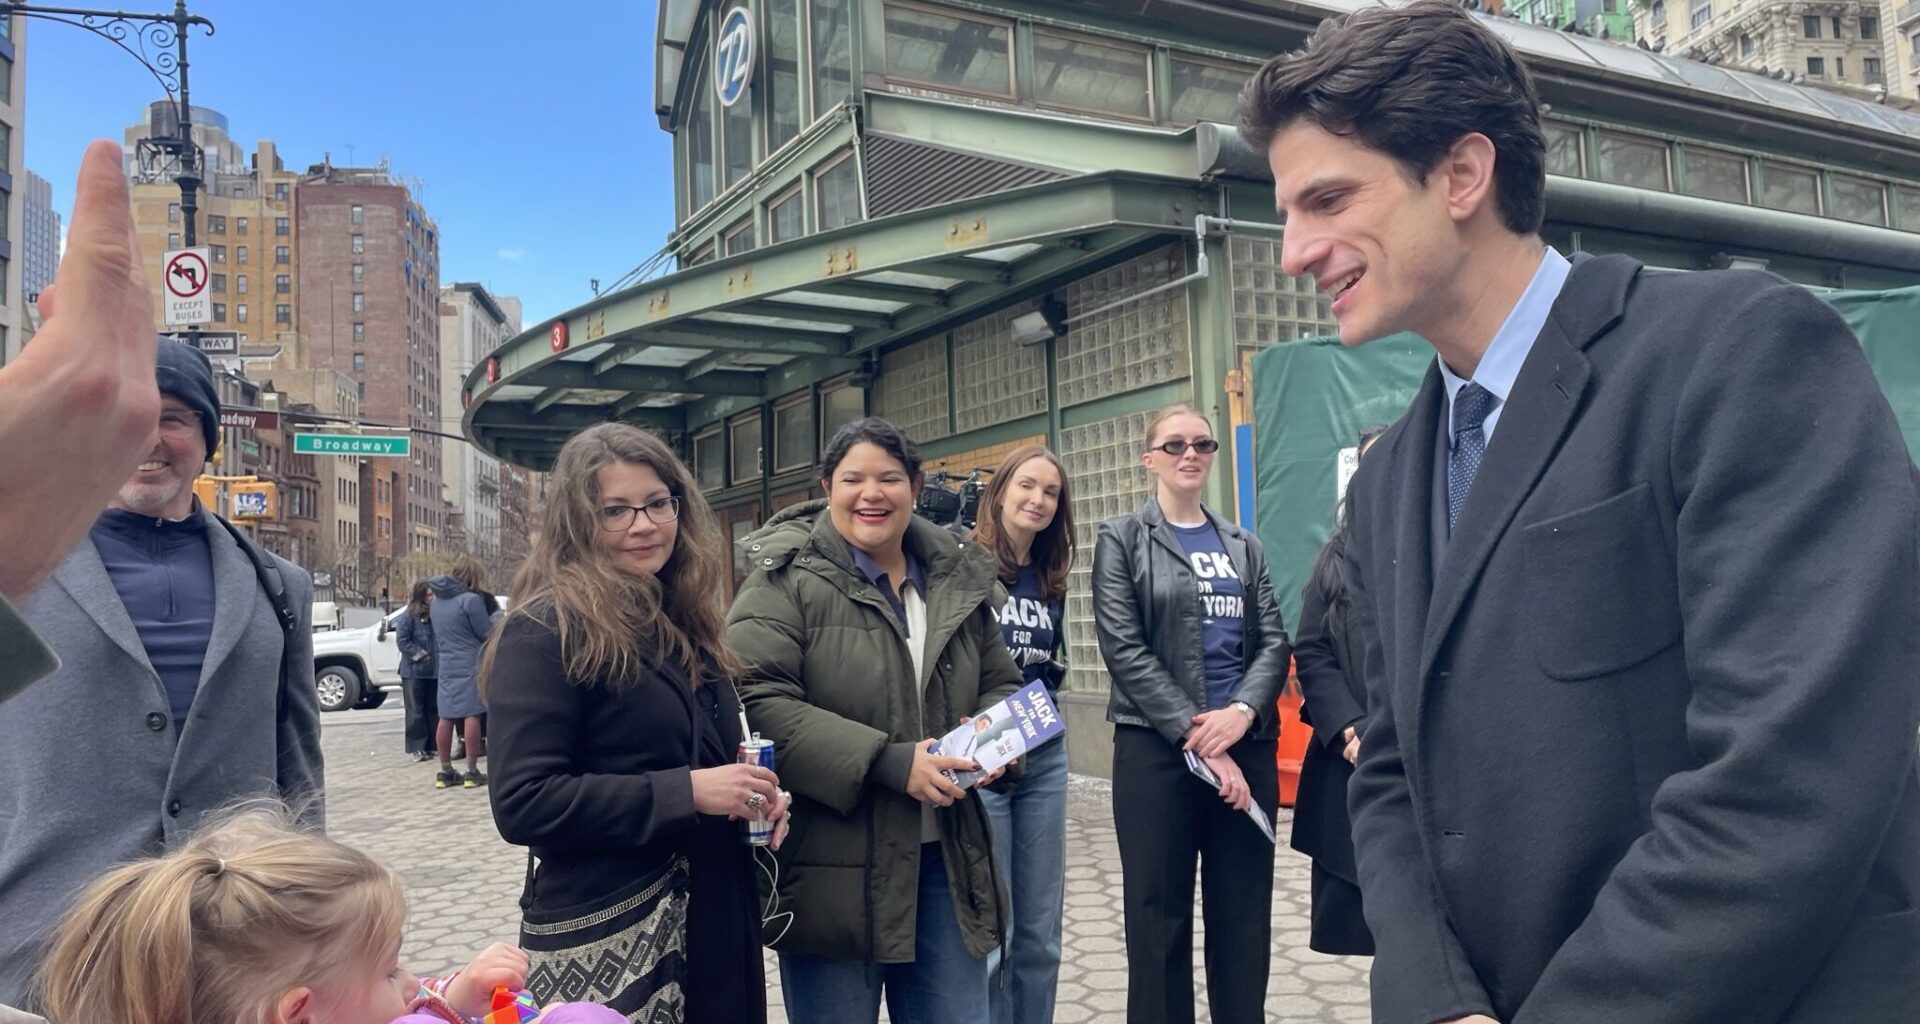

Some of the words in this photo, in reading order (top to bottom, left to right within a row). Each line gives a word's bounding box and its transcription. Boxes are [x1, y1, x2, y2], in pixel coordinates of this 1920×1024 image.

[720, 22, 748, 93] 72
[173, 301, 204, 311] EXCEPT
[175, 311, 203, 320] BUSES
[203, 339, 229, 349] WAY
[553, 326, 562, 348] 3
[220, 412, 257, 429] oadway
[313, 438, 393, 454] Broadway
[1190, 551, 1239, 579] CK
[1198, 581, 1213, 593] OR
[1012, 630, 1032, 645] FOR
[1027, 708, 1037, 720] FOR
[1028, 690, 1058, 729] JACK
[1011, 699, 1029, 718] NEW
[1021, 716, 1038, 739] YORK
